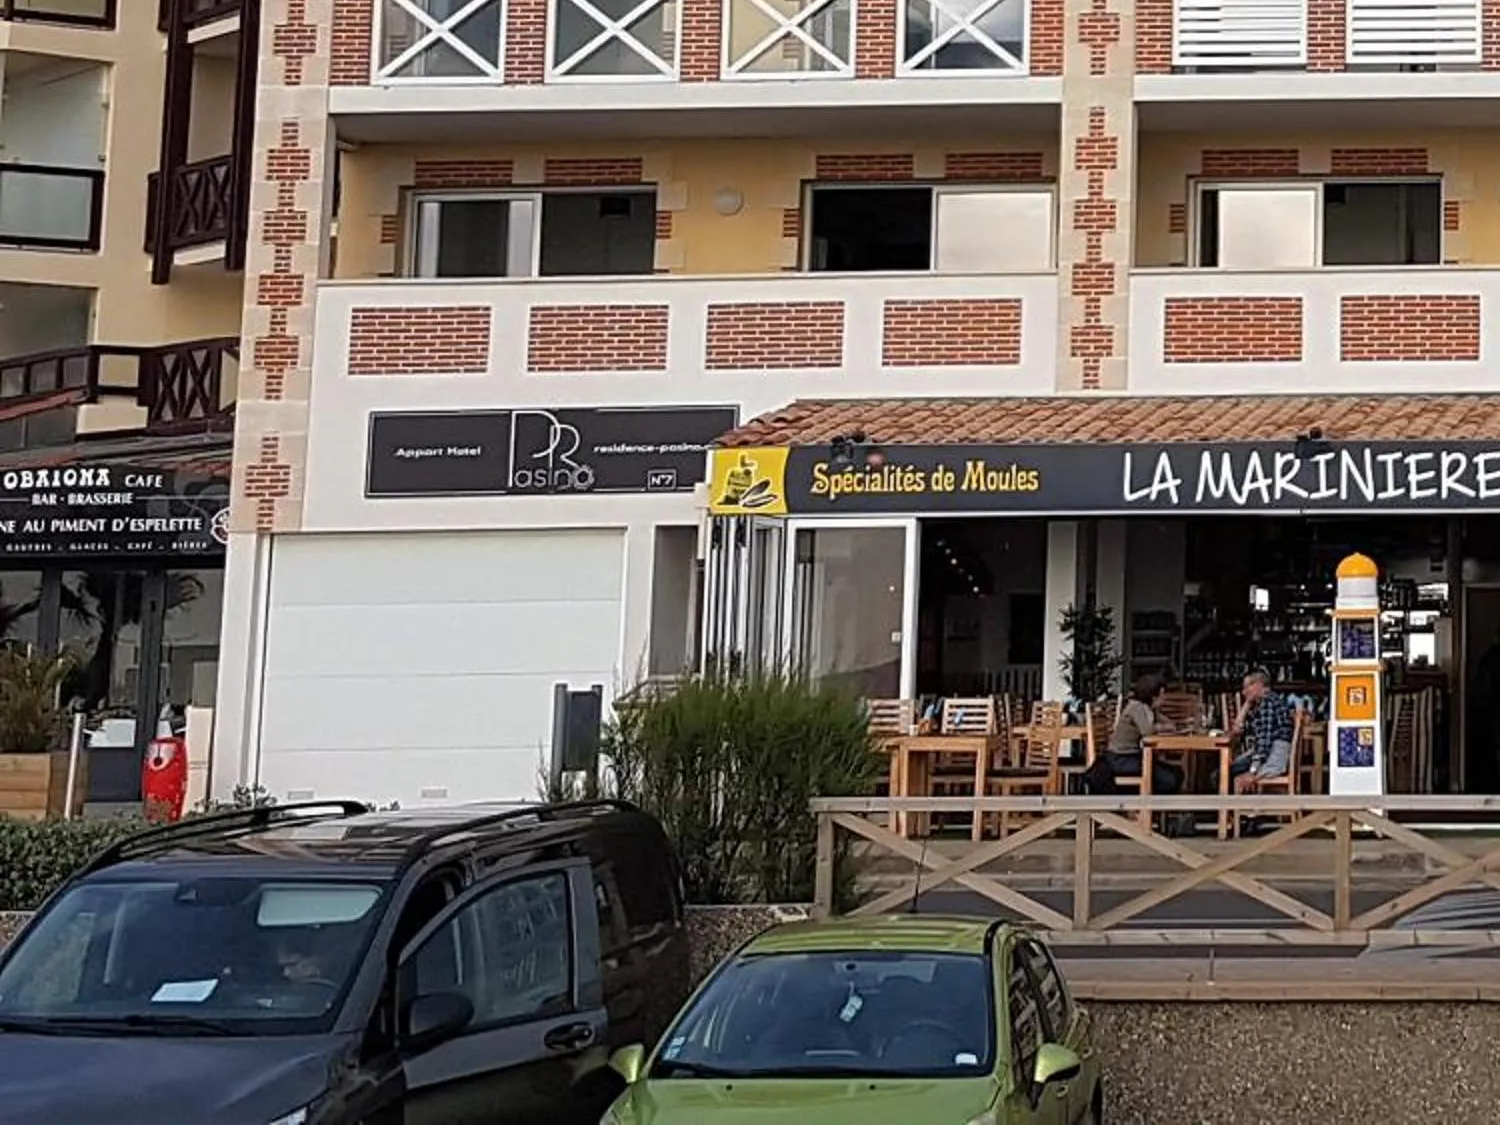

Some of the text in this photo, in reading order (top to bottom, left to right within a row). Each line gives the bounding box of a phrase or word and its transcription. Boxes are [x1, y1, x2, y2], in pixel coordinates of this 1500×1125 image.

[394, 446, 481, 459] Appart Hotel
[810, 460, 1039, 498] Spécialités de Moules
[1123, 451, 1180, 503] LA
[31, 492, 134, 506] BAR BRASSERIE
[22, 519, 46, 532] AU
[51, 518, 107, 532] PIMENT
[111, 516, 202, 532] D'ESPELETTE
